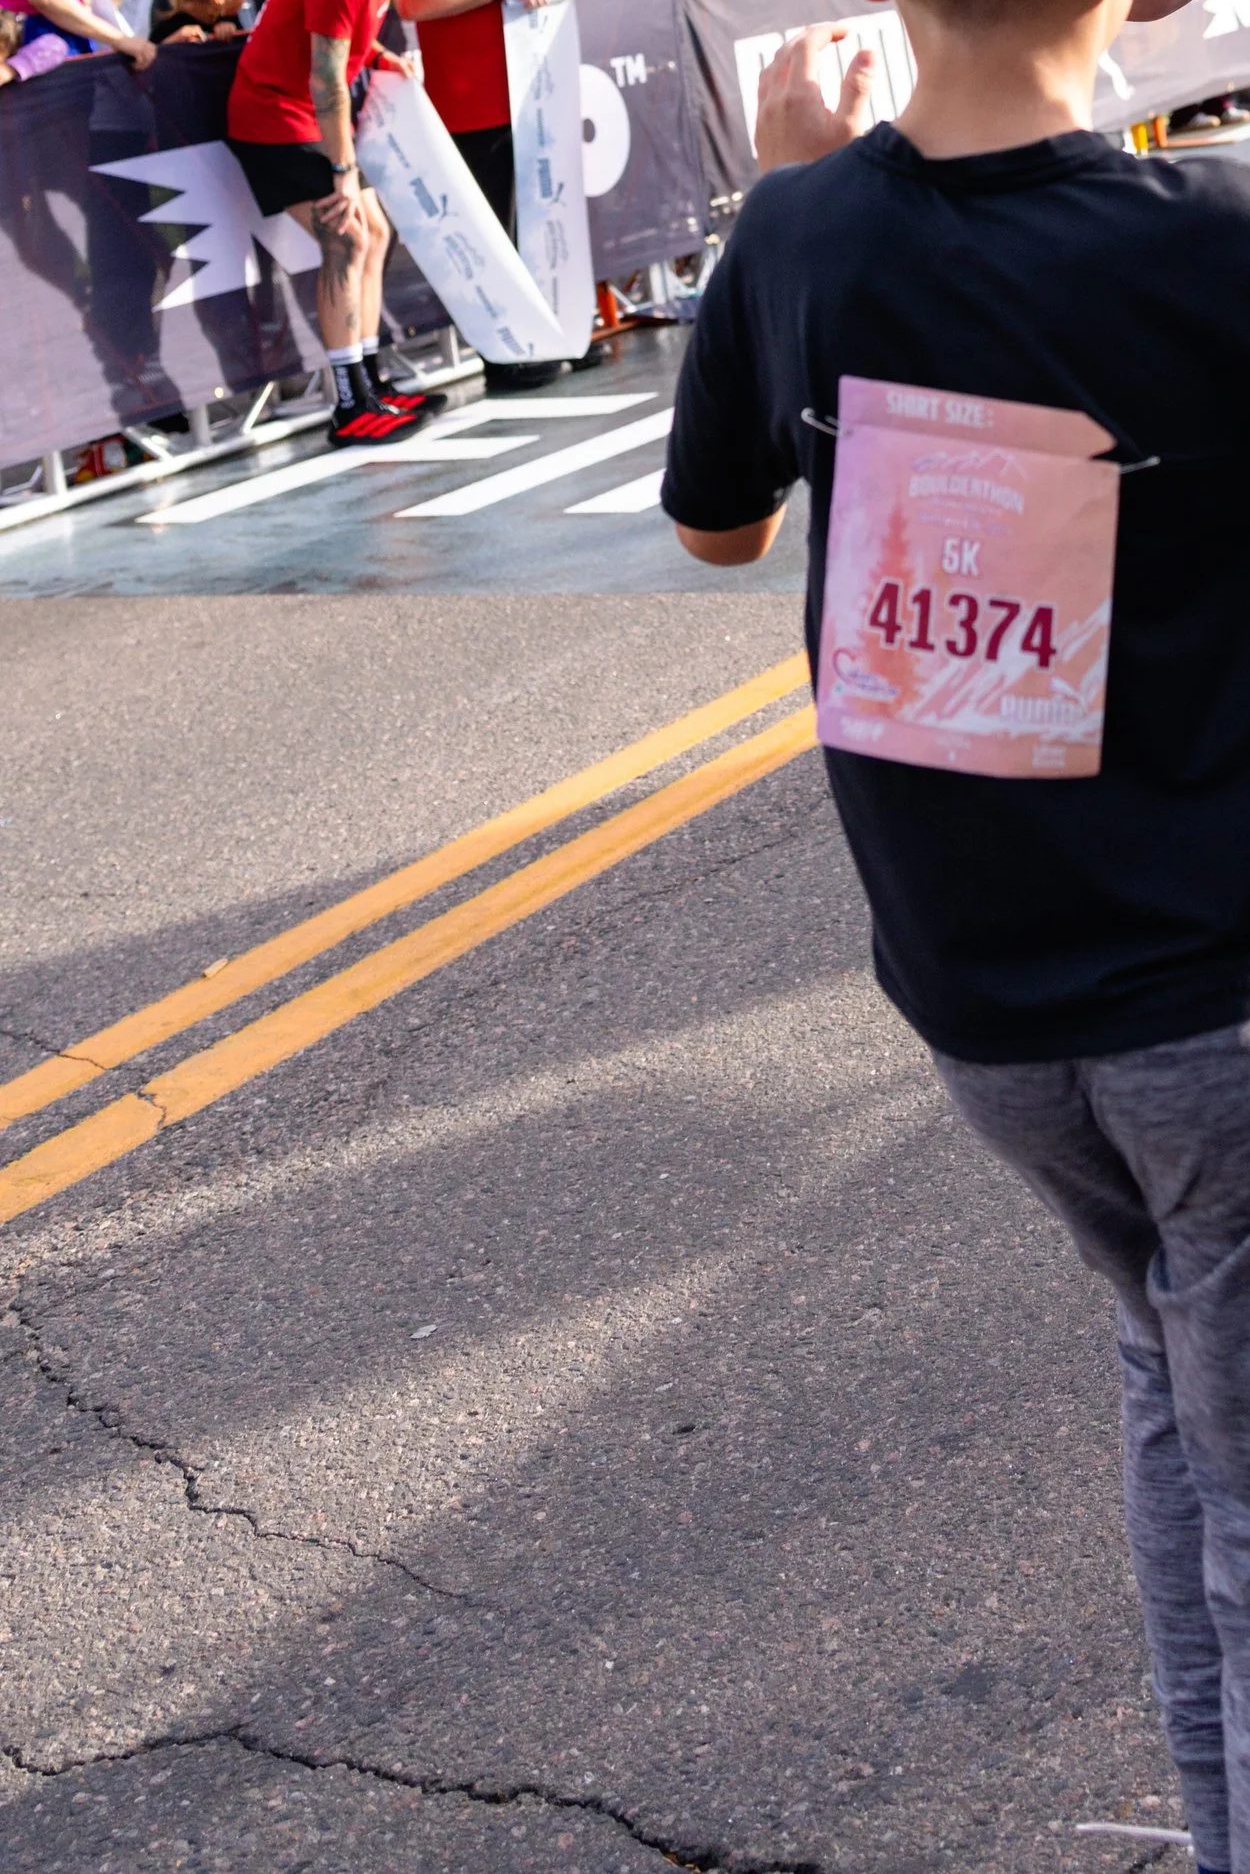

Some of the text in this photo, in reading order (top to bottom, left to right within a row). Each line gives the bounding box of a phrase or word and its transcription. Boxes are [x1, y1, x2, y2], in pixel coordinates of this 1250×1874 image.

[886, 389, 995, 429] SHIRT SIZE:
[941, 536, 982, 576] 5K
[865, 581, 1058, 670] 41374
